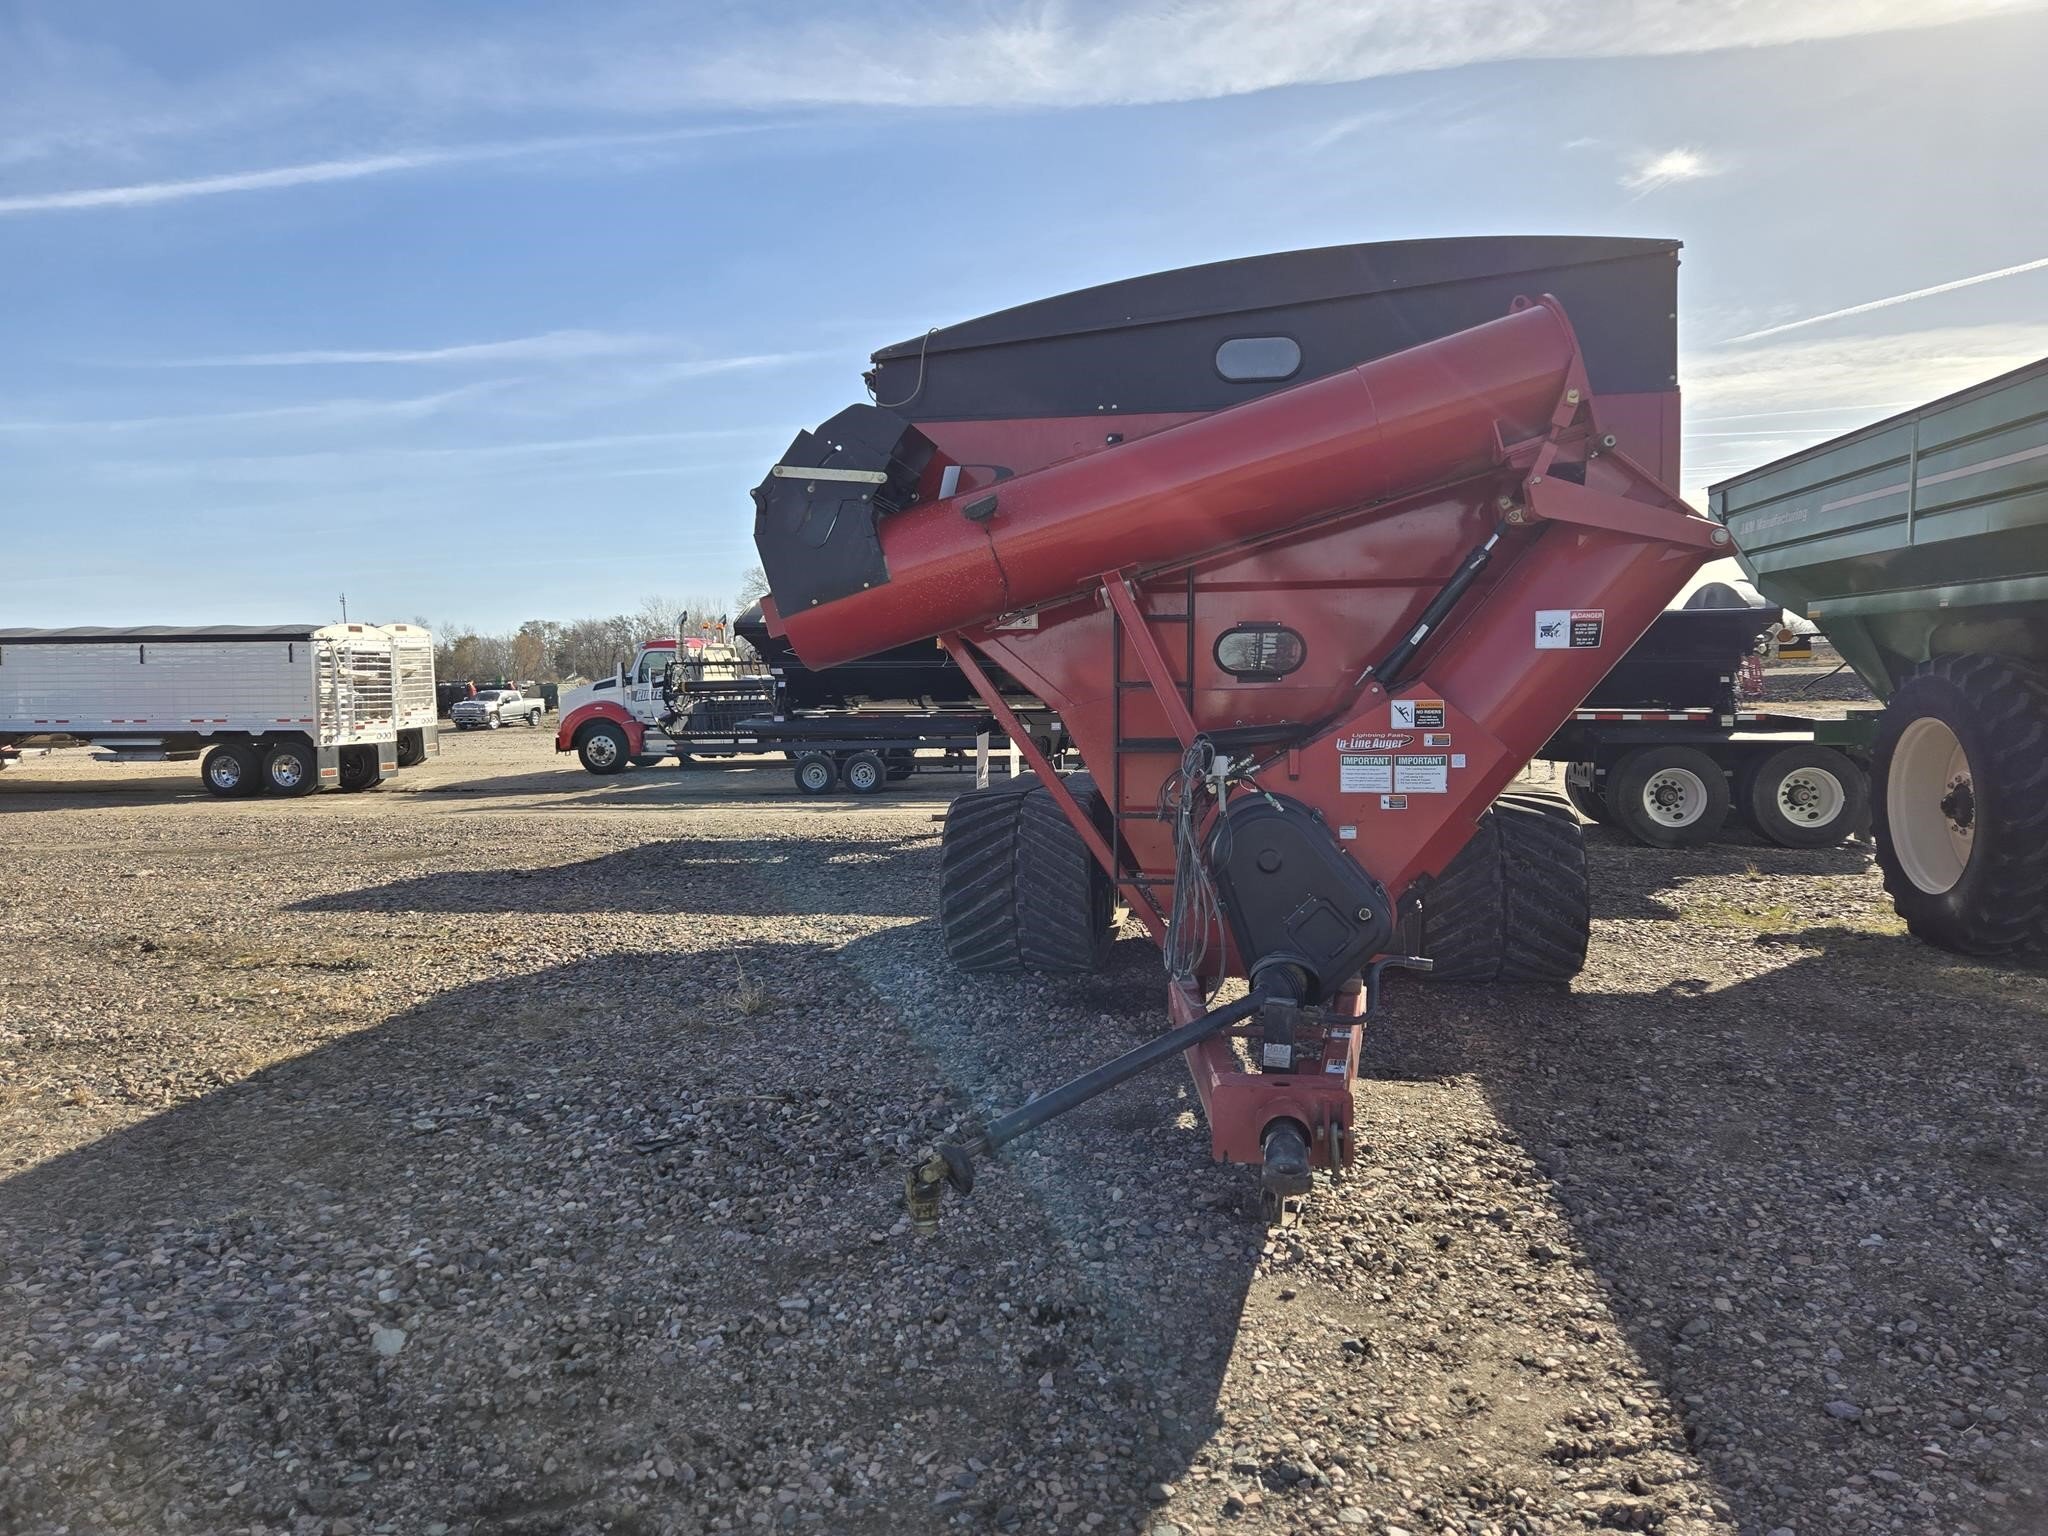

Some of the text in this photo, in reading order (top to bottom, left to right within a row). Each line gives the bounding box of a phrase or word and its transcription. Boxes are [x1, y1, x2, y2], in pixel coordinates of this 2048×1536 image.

[1336, 737, 1403, 749] In-Line Auger
[1343, 756, 1389, 765] IMPORTANT
[1398, 756, 1443, 765] IMPORTANT
